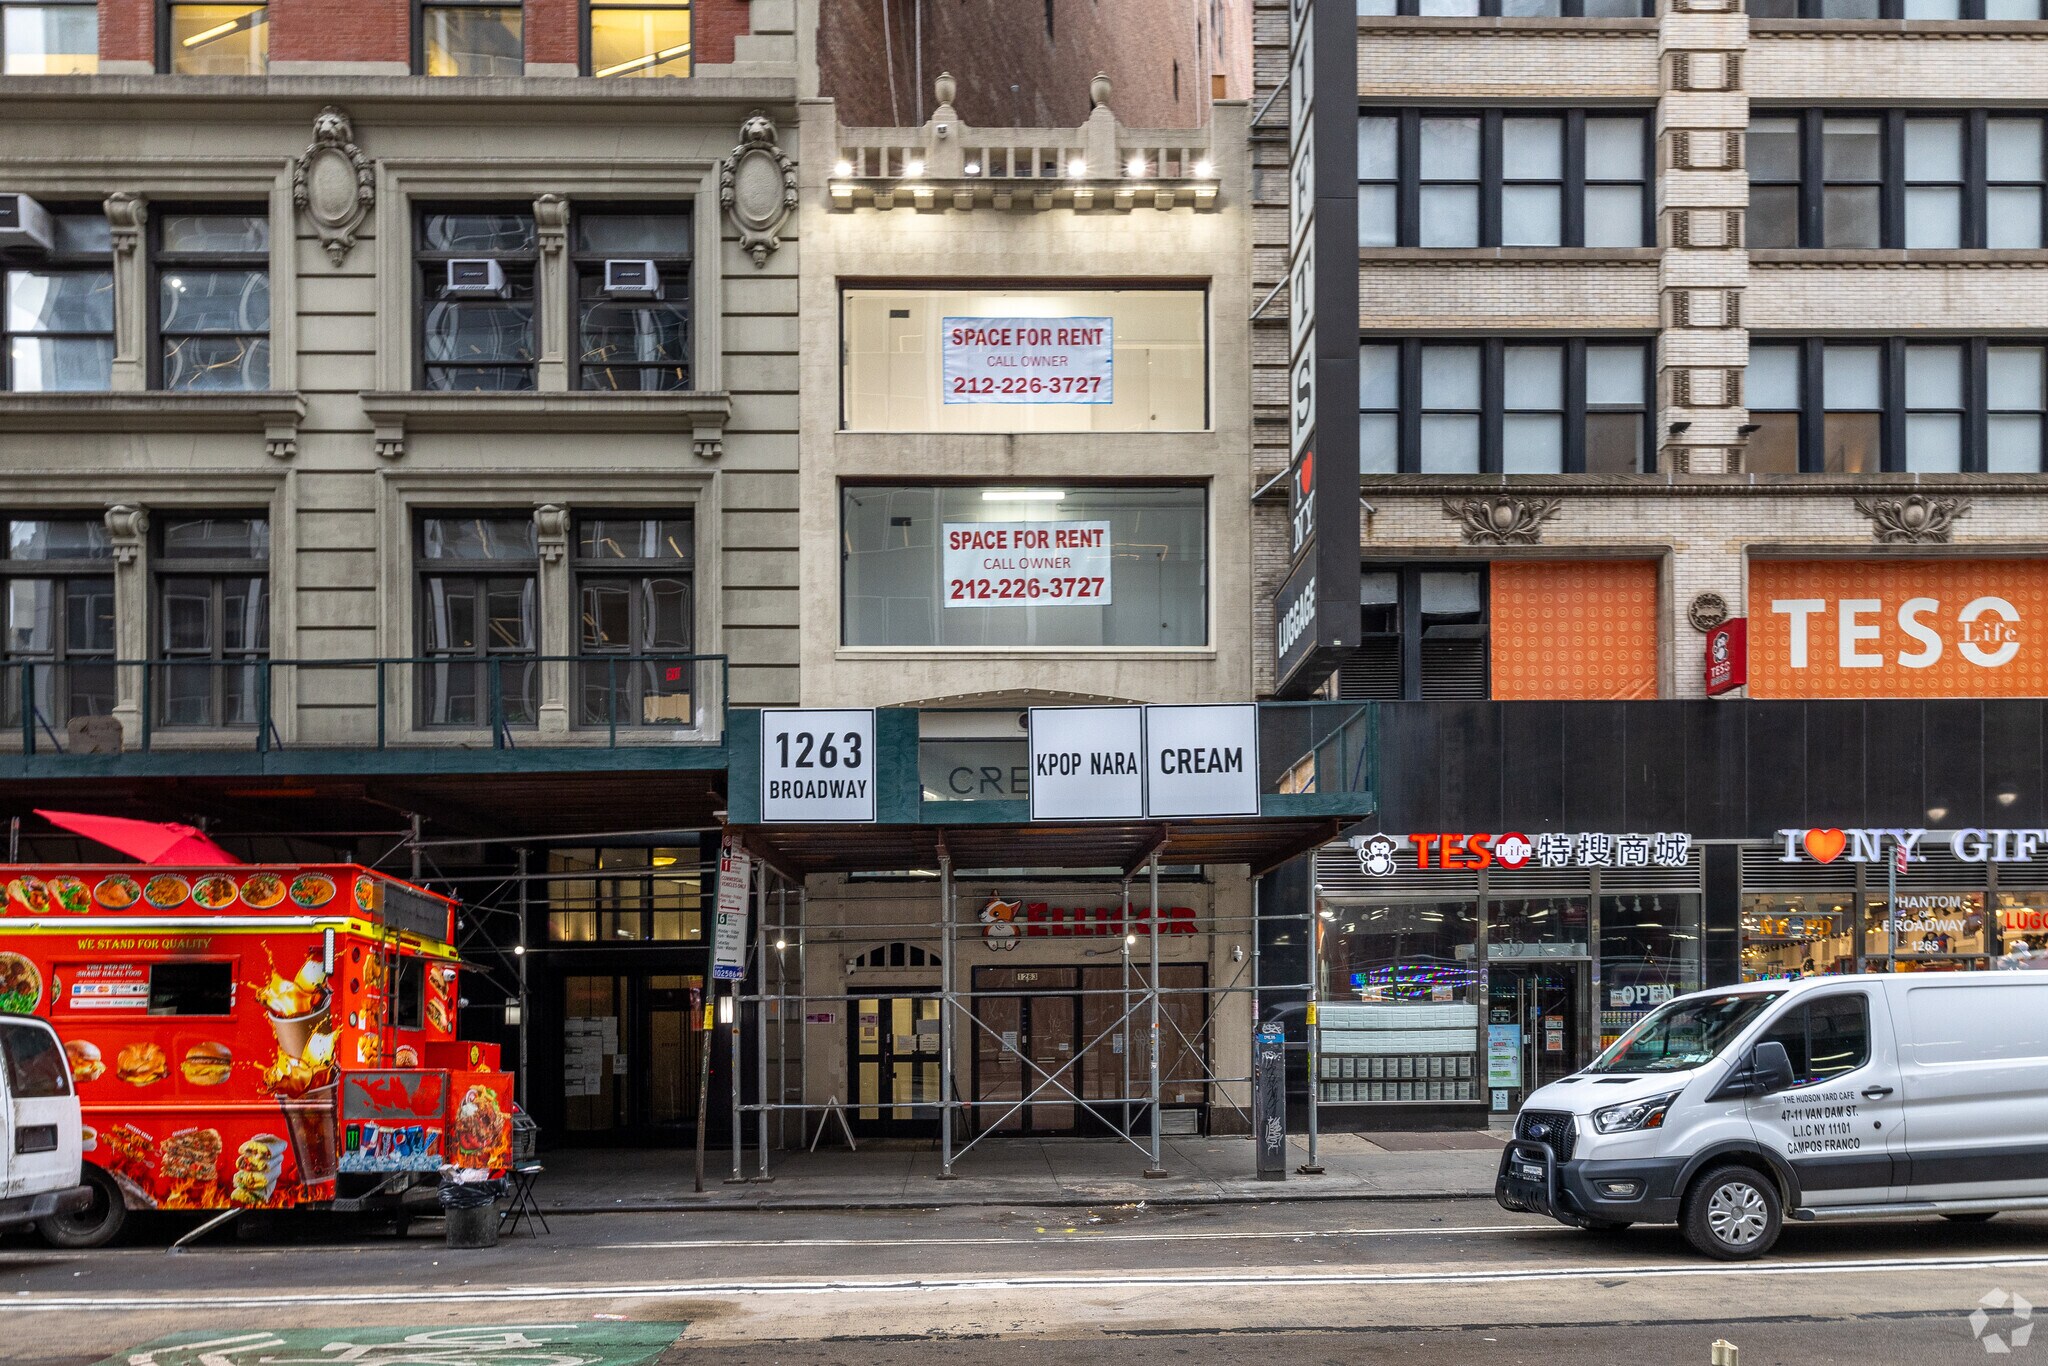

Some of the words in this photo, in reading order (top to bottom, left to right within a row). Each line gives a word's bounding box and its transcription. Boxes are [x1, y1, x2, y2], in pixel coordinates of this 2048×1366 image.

[1294, 0, 1312, 436] IFTS
[952, 328, 1011, 346] SPACE
[1017, 328, 1052, 346] FOR
[1057, 328, 1104, 346] RENT
[987, 355, 1017, 367] CALL
[1021, 355, 1069, 367] OWNER
[953, 376, 1101, 394] 212-226-3727
[1293, 490, 1316, 554] NY
[950, 530, 1007, 550] SPACE
[1014, 530, 1049, 549] FOR
[1056, 529, 1104, 548] RENT
[984, 557, 1015, 570] CALL
[1019, 557, 1071, 569] OWNER
[951, 577, 1104, 599] 212-226-3727
[1278, 577, 1316, 658] LUGGAGE
[1964, 622, 2017, 643] Life
[775, 732, 862, 768] 1263
[1037, 752, 1082, 776] KPOP
[1090, 752, 1138, 775] NARA
[1160, 747, 1243, 775] CREAM
[770, 780, 867, 799] BROADWAY
[1497, 844, 1530, 857] Life
[1539, 832, 1689, 867] 特搜商城
[1952, 828, 2048, 862] GIF
[719, 914, 725, 924] 6
[1883, 920, 1966, 932] BROADWAY
[78, 939, 94, 949] WE
[98, 939, 134, 949] STAND
[138, 938, 159, 949] FOR
[162, 937, 212, 949] QUALITY
[1912, 941, 1939, 952] 1265
[1018, 973, 1038, 981] 1263
[1622, 984, 1675, 1005] OPEN
[1783, 1095, 1794, 1104] THE
[1796, 1093, 1820, 1103] HUDSON
[1822, 1092, 1838, 1101] YARD
[1839, 1091, 1854, 1100] CAFE
[1782, 1109, 1802, 1121] 47-11
[1805, 1106, 1822, 1120] VAN
[1825, 1105, 1843, 1119] DAM
[1846, 1105, 1858, 1117] ST.
[1792, 1125, 1812, 1137] L.I.C
[1814, 1123, 1826, 1136] NY
[1828, 1122, 1851, 1135] 11101
[1787, 1140, 1822, 1154] CAMPOS
[1825, 1138, 1860, 1151] FRANCO
